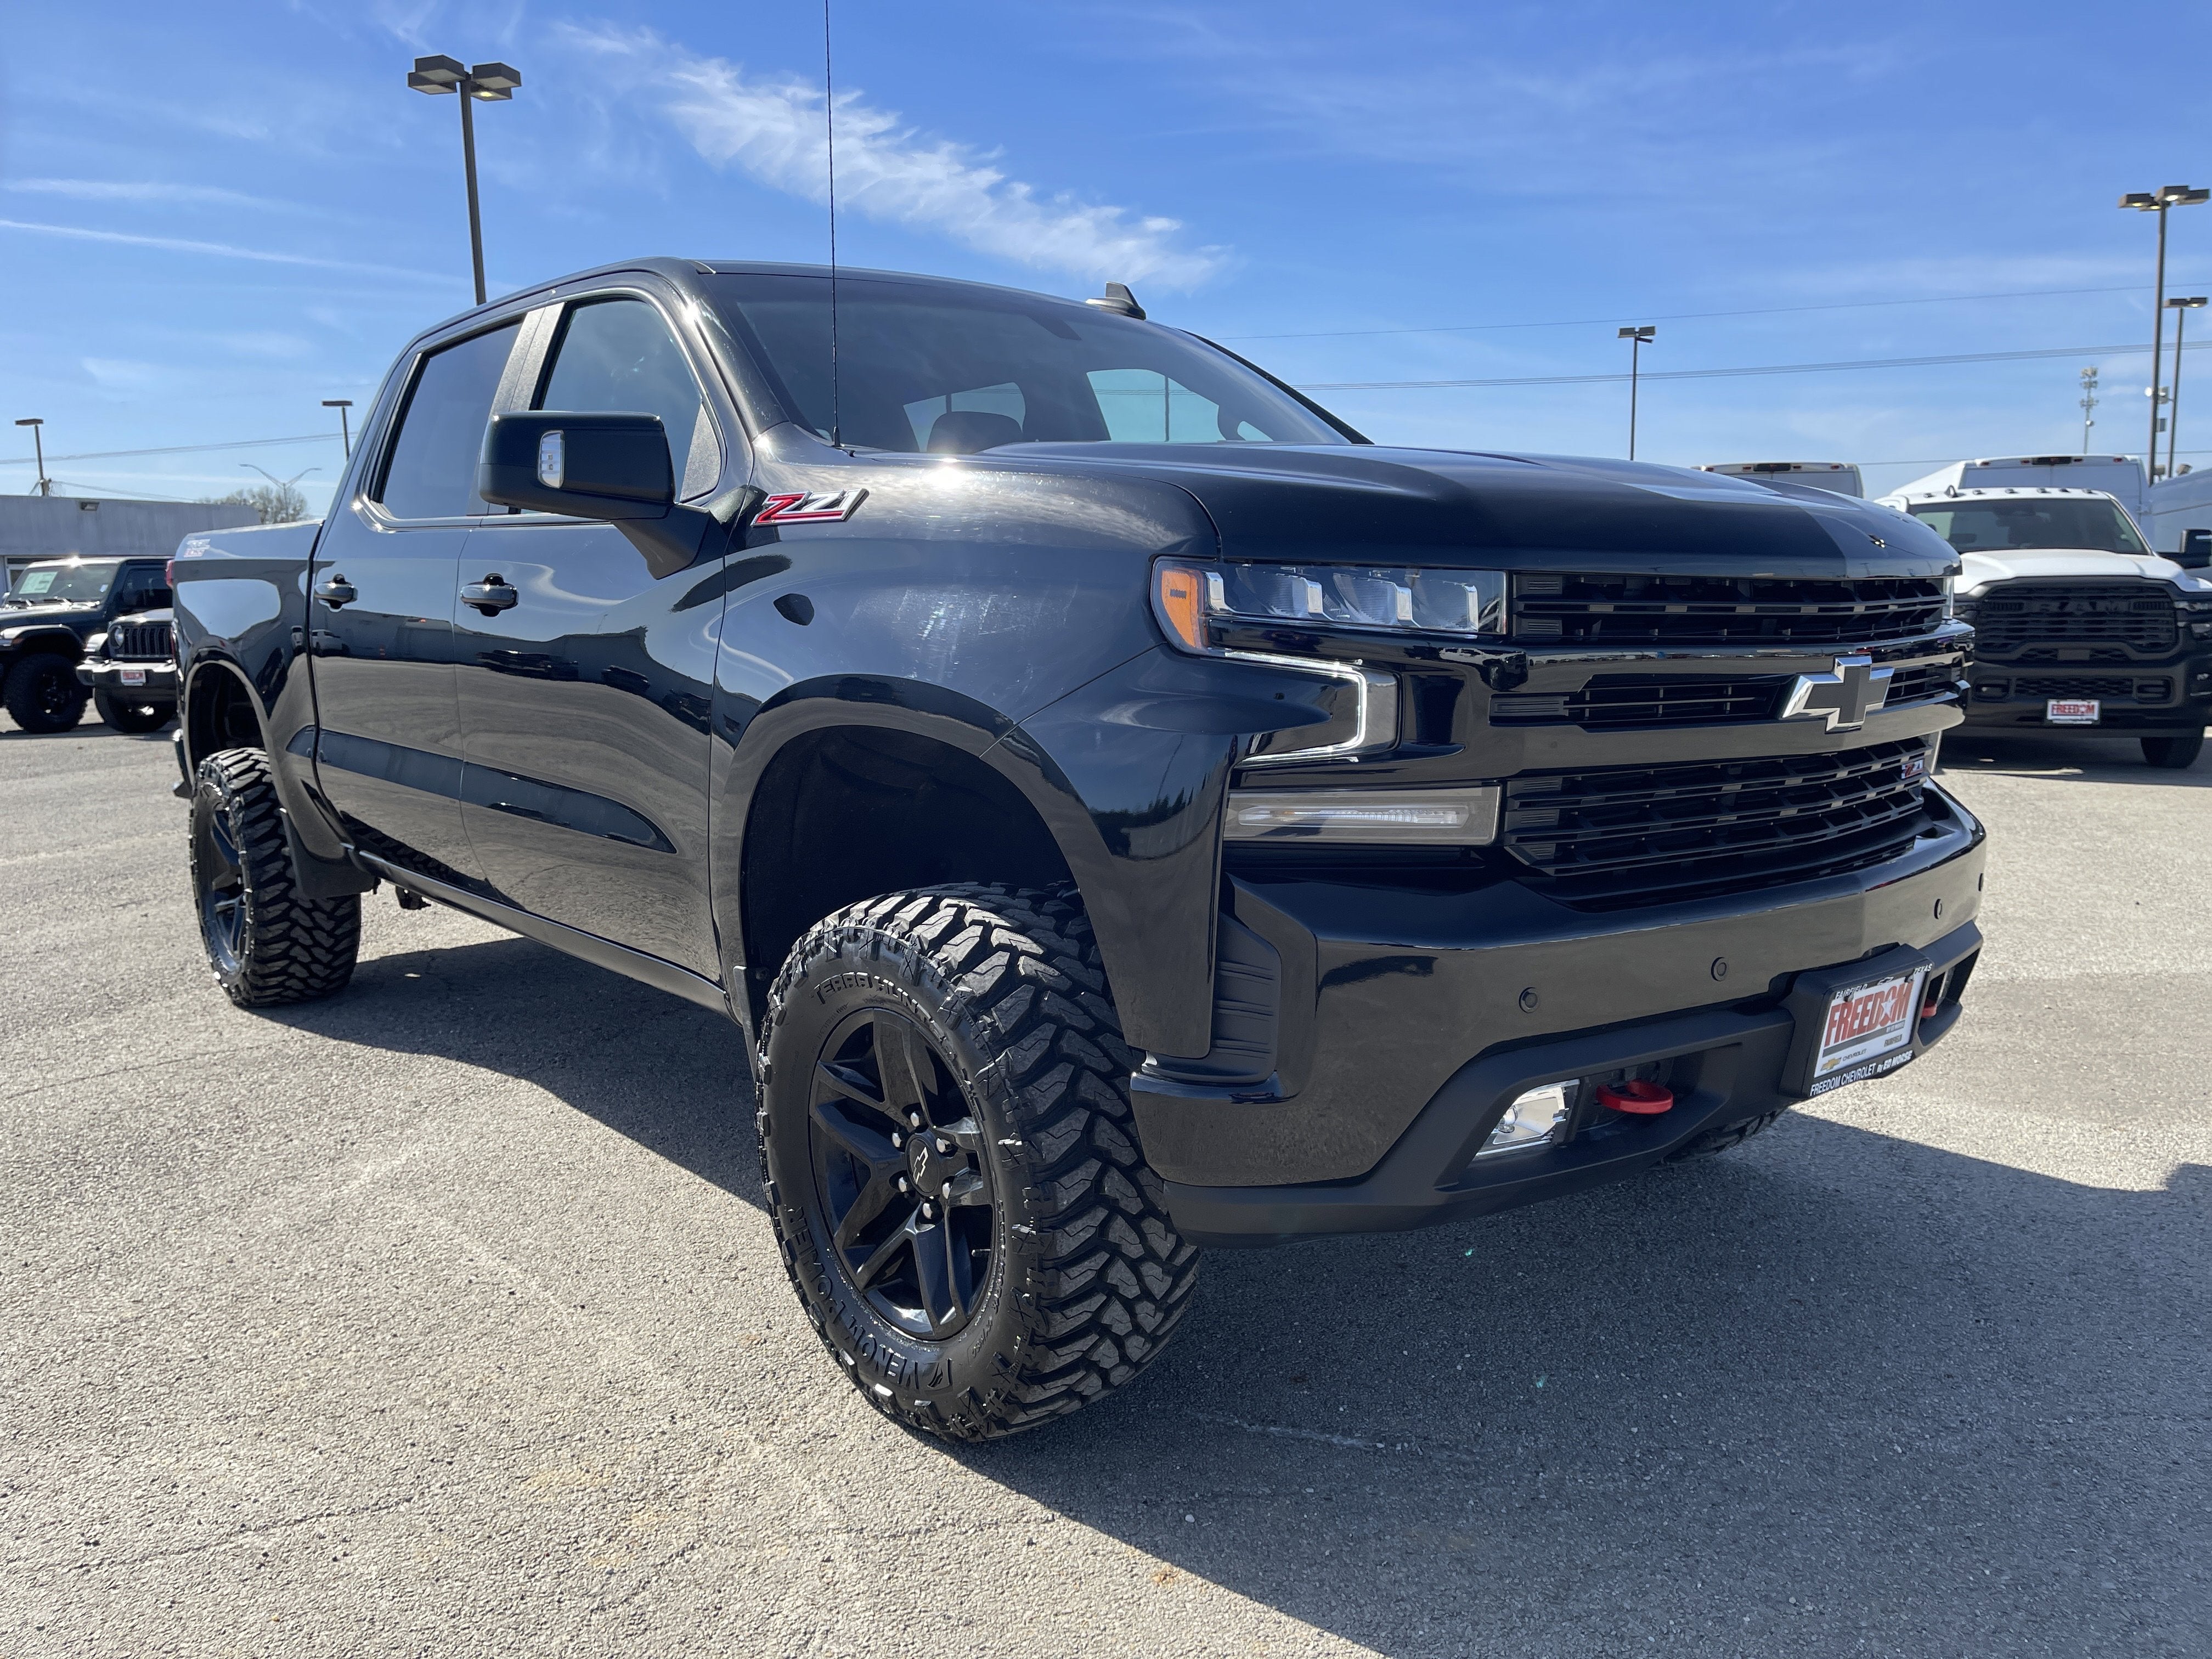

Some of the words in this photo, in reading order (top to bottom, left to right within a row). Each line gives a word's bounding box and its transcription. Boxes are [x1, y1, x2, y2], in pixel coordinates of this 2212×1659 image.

[750, 488, 870, 528] Z71
[1912, 964, 1933, 975] TEXAS
[1824, 983, 1914, 1047] FREEDOM
[1842, 1049, 1866, 1062] CHEVROLET
[1810, 1077, 1841, 1097] FREEDOM
[1841, 1063, 1876, 1086] CHEVROLET
